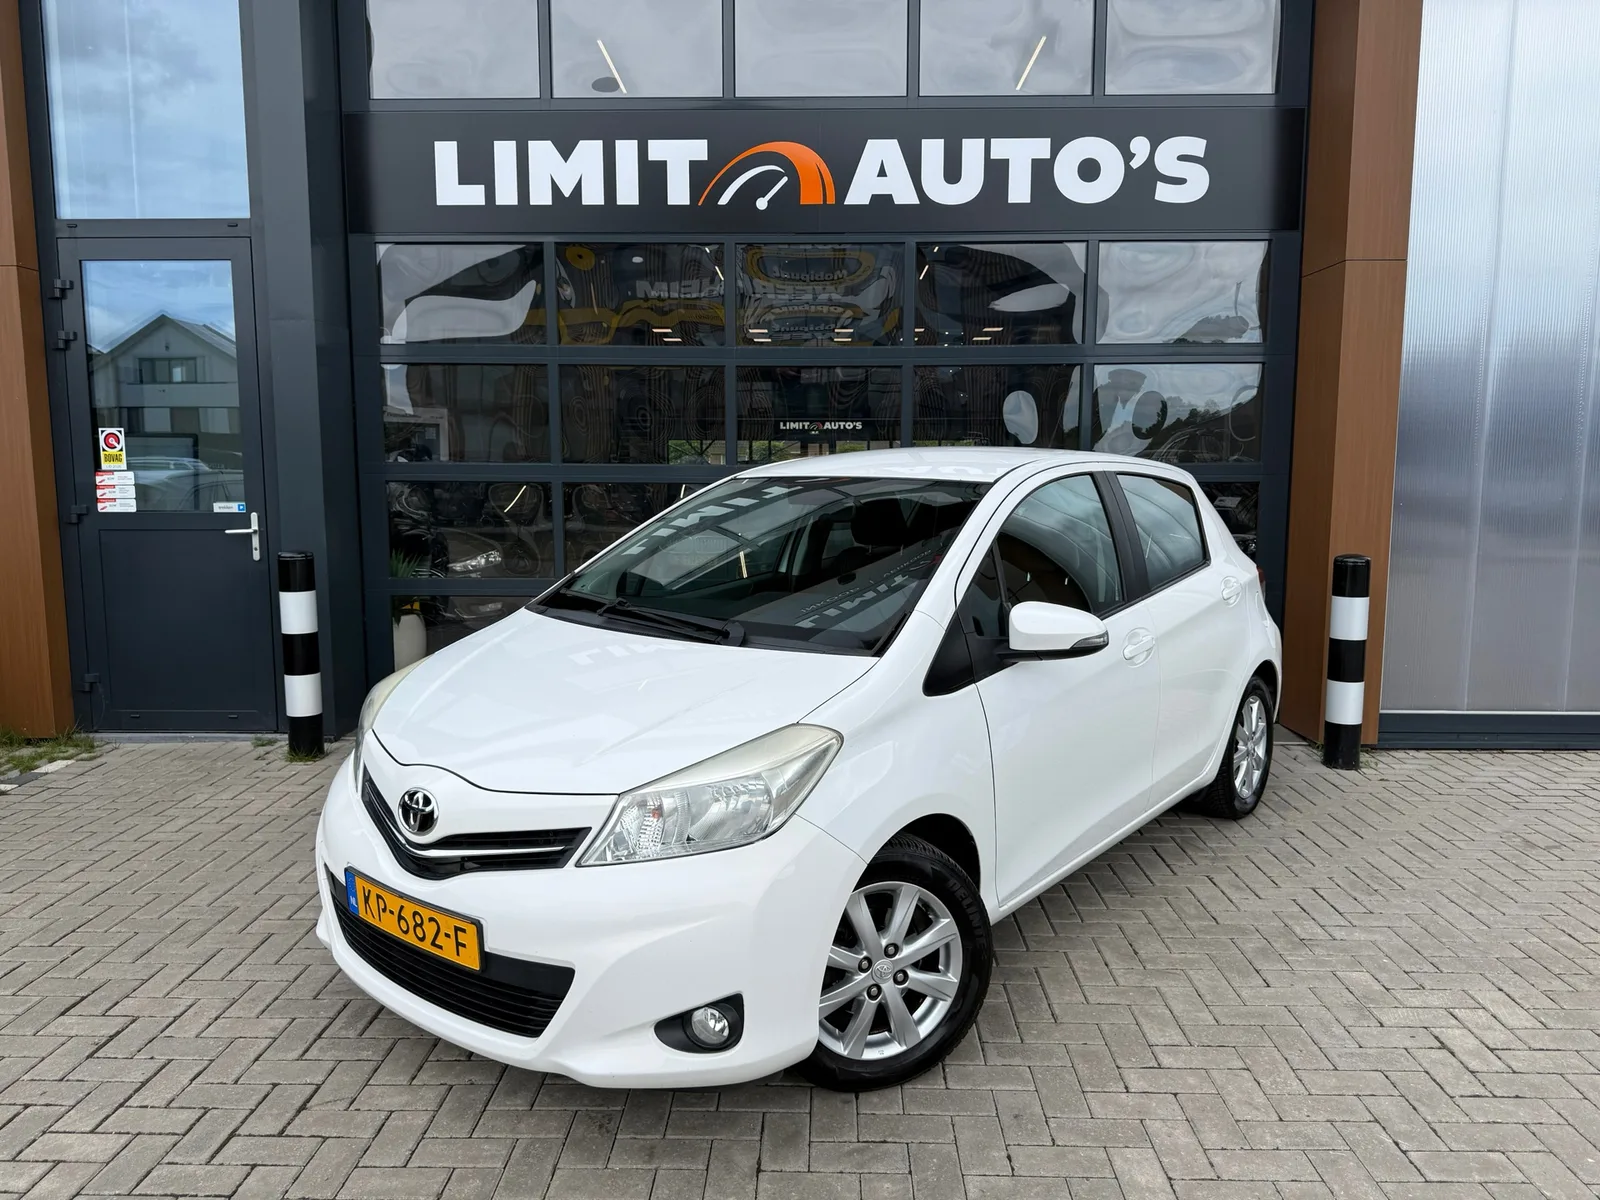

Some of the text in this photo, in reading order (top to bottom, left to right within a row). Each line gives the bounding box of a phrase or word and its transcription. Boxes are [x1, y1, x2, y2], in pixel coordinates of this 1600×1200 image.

[434, 136, 1209, 206] LIMIT AUTO'S
[779, 421, 863, 430] LIMIT AUTO'S
[104, 453, 123, 463] BOVAG
[350, 895, 358, 907] NL
[361, 885, 467, 957] KP-682-F
